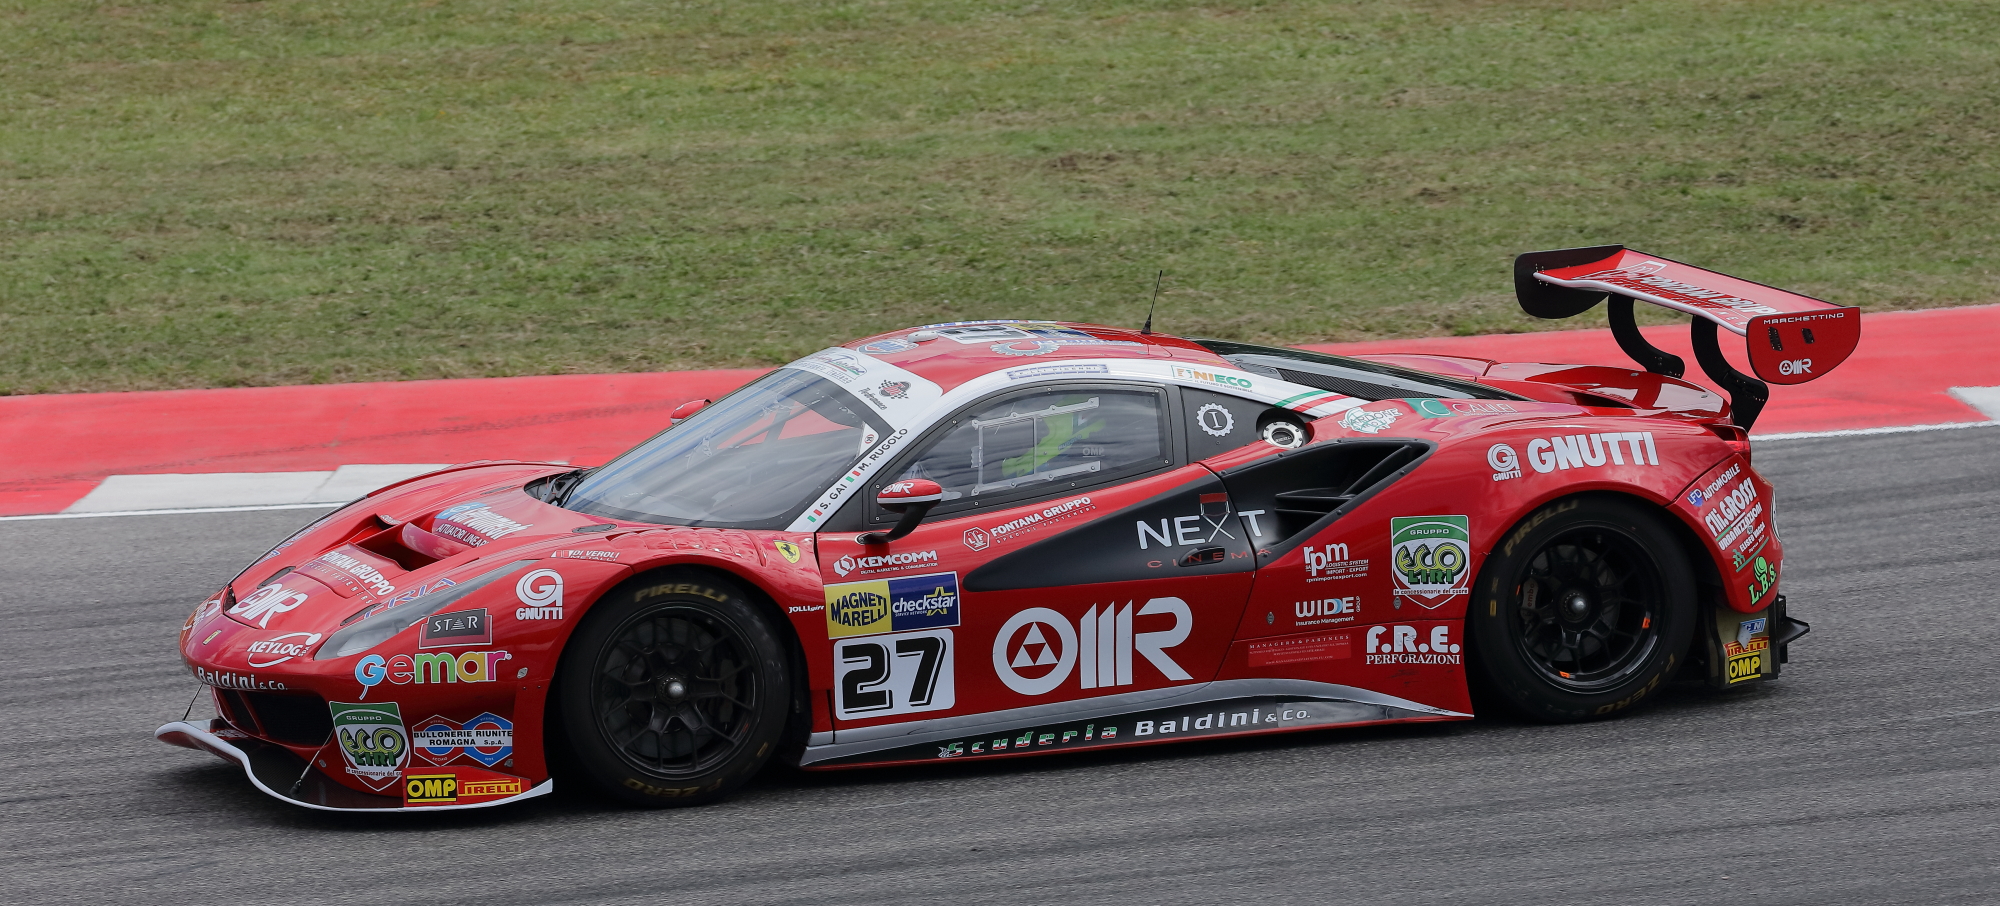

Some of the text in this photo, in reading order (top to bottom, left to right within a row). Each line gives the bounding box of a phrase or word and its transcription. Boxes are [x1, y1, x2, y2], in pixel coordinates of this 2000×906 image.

[1763, 312, 1844, 325] MARCHETTINO
[858, 462, 872, 472] M.
[869, 428, 908, 461] RUGOLO
[1527, 431, 1660, 474] GNUTTI
[1492, 469, 1522, 482] GNUTTI
[1702, 462, 1741, 501] AUTOMOBILE
[820, 483, 848, 510] S. GAI
[990, 496, 1092, 537] FONTANA GRUPPO
[996, 505, 1097, 544] SPECIAL FASTENERS
[1136, 508, 1265, 550] NEXT
[1409, 528, 1450, 536] GRUPPO
[1504, 498, 1581, 557] PIRELLI
[586, 550, 621, 559] VEROLI
[857, 550, 938, 569] KEMCOMM
[1146, 548, 1272, 569] CINEMA
[1303, 542, 1349, 577] rpm
[1325, 560, 1348, 568] LOGISTIC
[1394, 541, 1467, 578] ECO
[349, 564, 396, 596] GRUPPO
[1407, 568, 1455, 585] LIRI
[634, 583, 729, 602] PIRELLI
[831, 591, 888, 613] MAGNETI
[515, 606, 563, 621] GNUTTI
[892, 594, 957, 614] checkstar
[1295, 596, 1355, 618] WIDE
[831, 606, 888, 627] MARELLI
[1295, 615, 1355, 627] Insurance Management
[246, 640, 304, 657] KEYLOG
[1249, 640, 1296, 650] MANAGERS
[1305, 634, 1349, 644] PARTNERS
[1366, 625, 1460, 654] F.R.E.
[1365, 653, 1461, 665] PERFORAZIONI
[1729, 656, 1761, 678] OMP
[197, 665, 257, 690] Baldini
[842, 636, 947, 714] 27
[1594, 672, 1660, 716] ZERO
[413, 730, 473, 738] BULLONERIE
[429, 738, 476, 746] ROMAGNA
[942, 723, 1118, 758] Scuderia
[1134, 708, 1260, 737] Baldini
[406, 778, 457, 798] OMP
[457, 778, 522, 797] PIRELLI
[622, 777, 700, 798] ZERO
